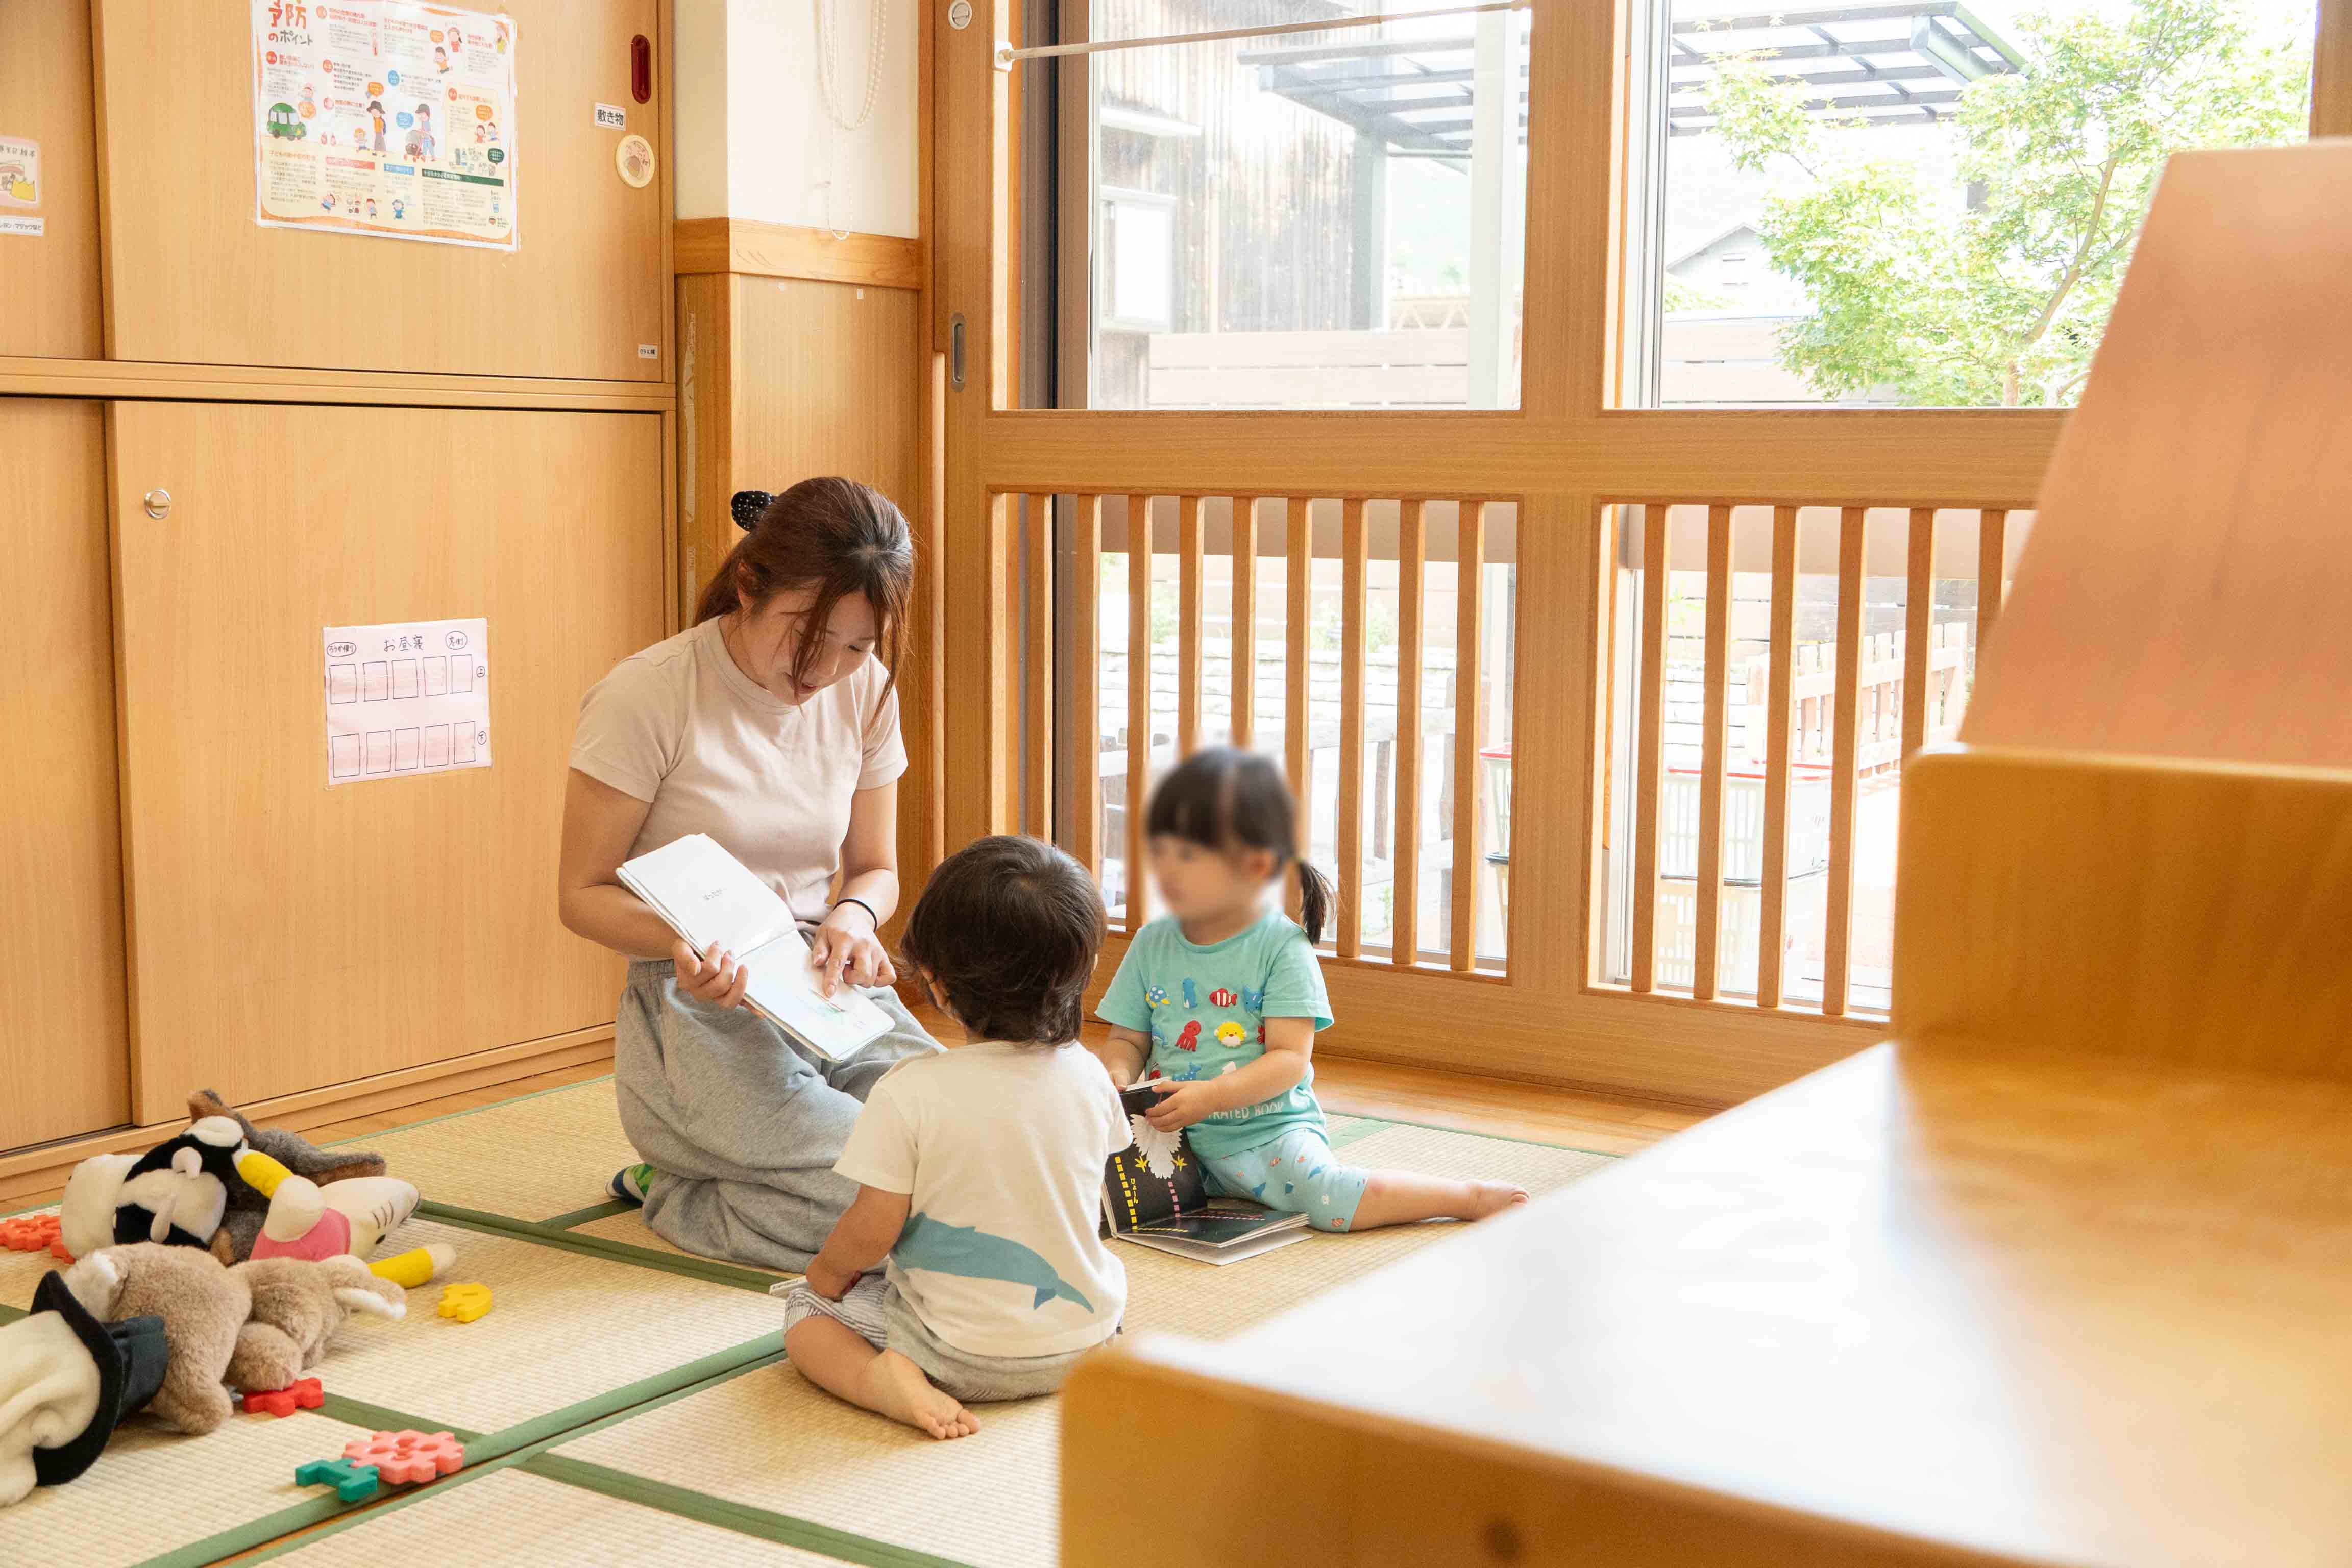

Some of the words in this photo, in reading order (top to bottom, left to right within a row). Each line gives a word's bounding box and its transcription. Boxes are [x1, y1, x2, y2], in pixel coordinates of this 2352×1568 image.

[268, 0, 307, 29] 予防
[268, 29, 313, 46] のポイント
[596, 108, 624, 126] 敷き物
[383, 634, 424, 652] お昼寝
[1254, 1102, 1283, 1116] BOOK
